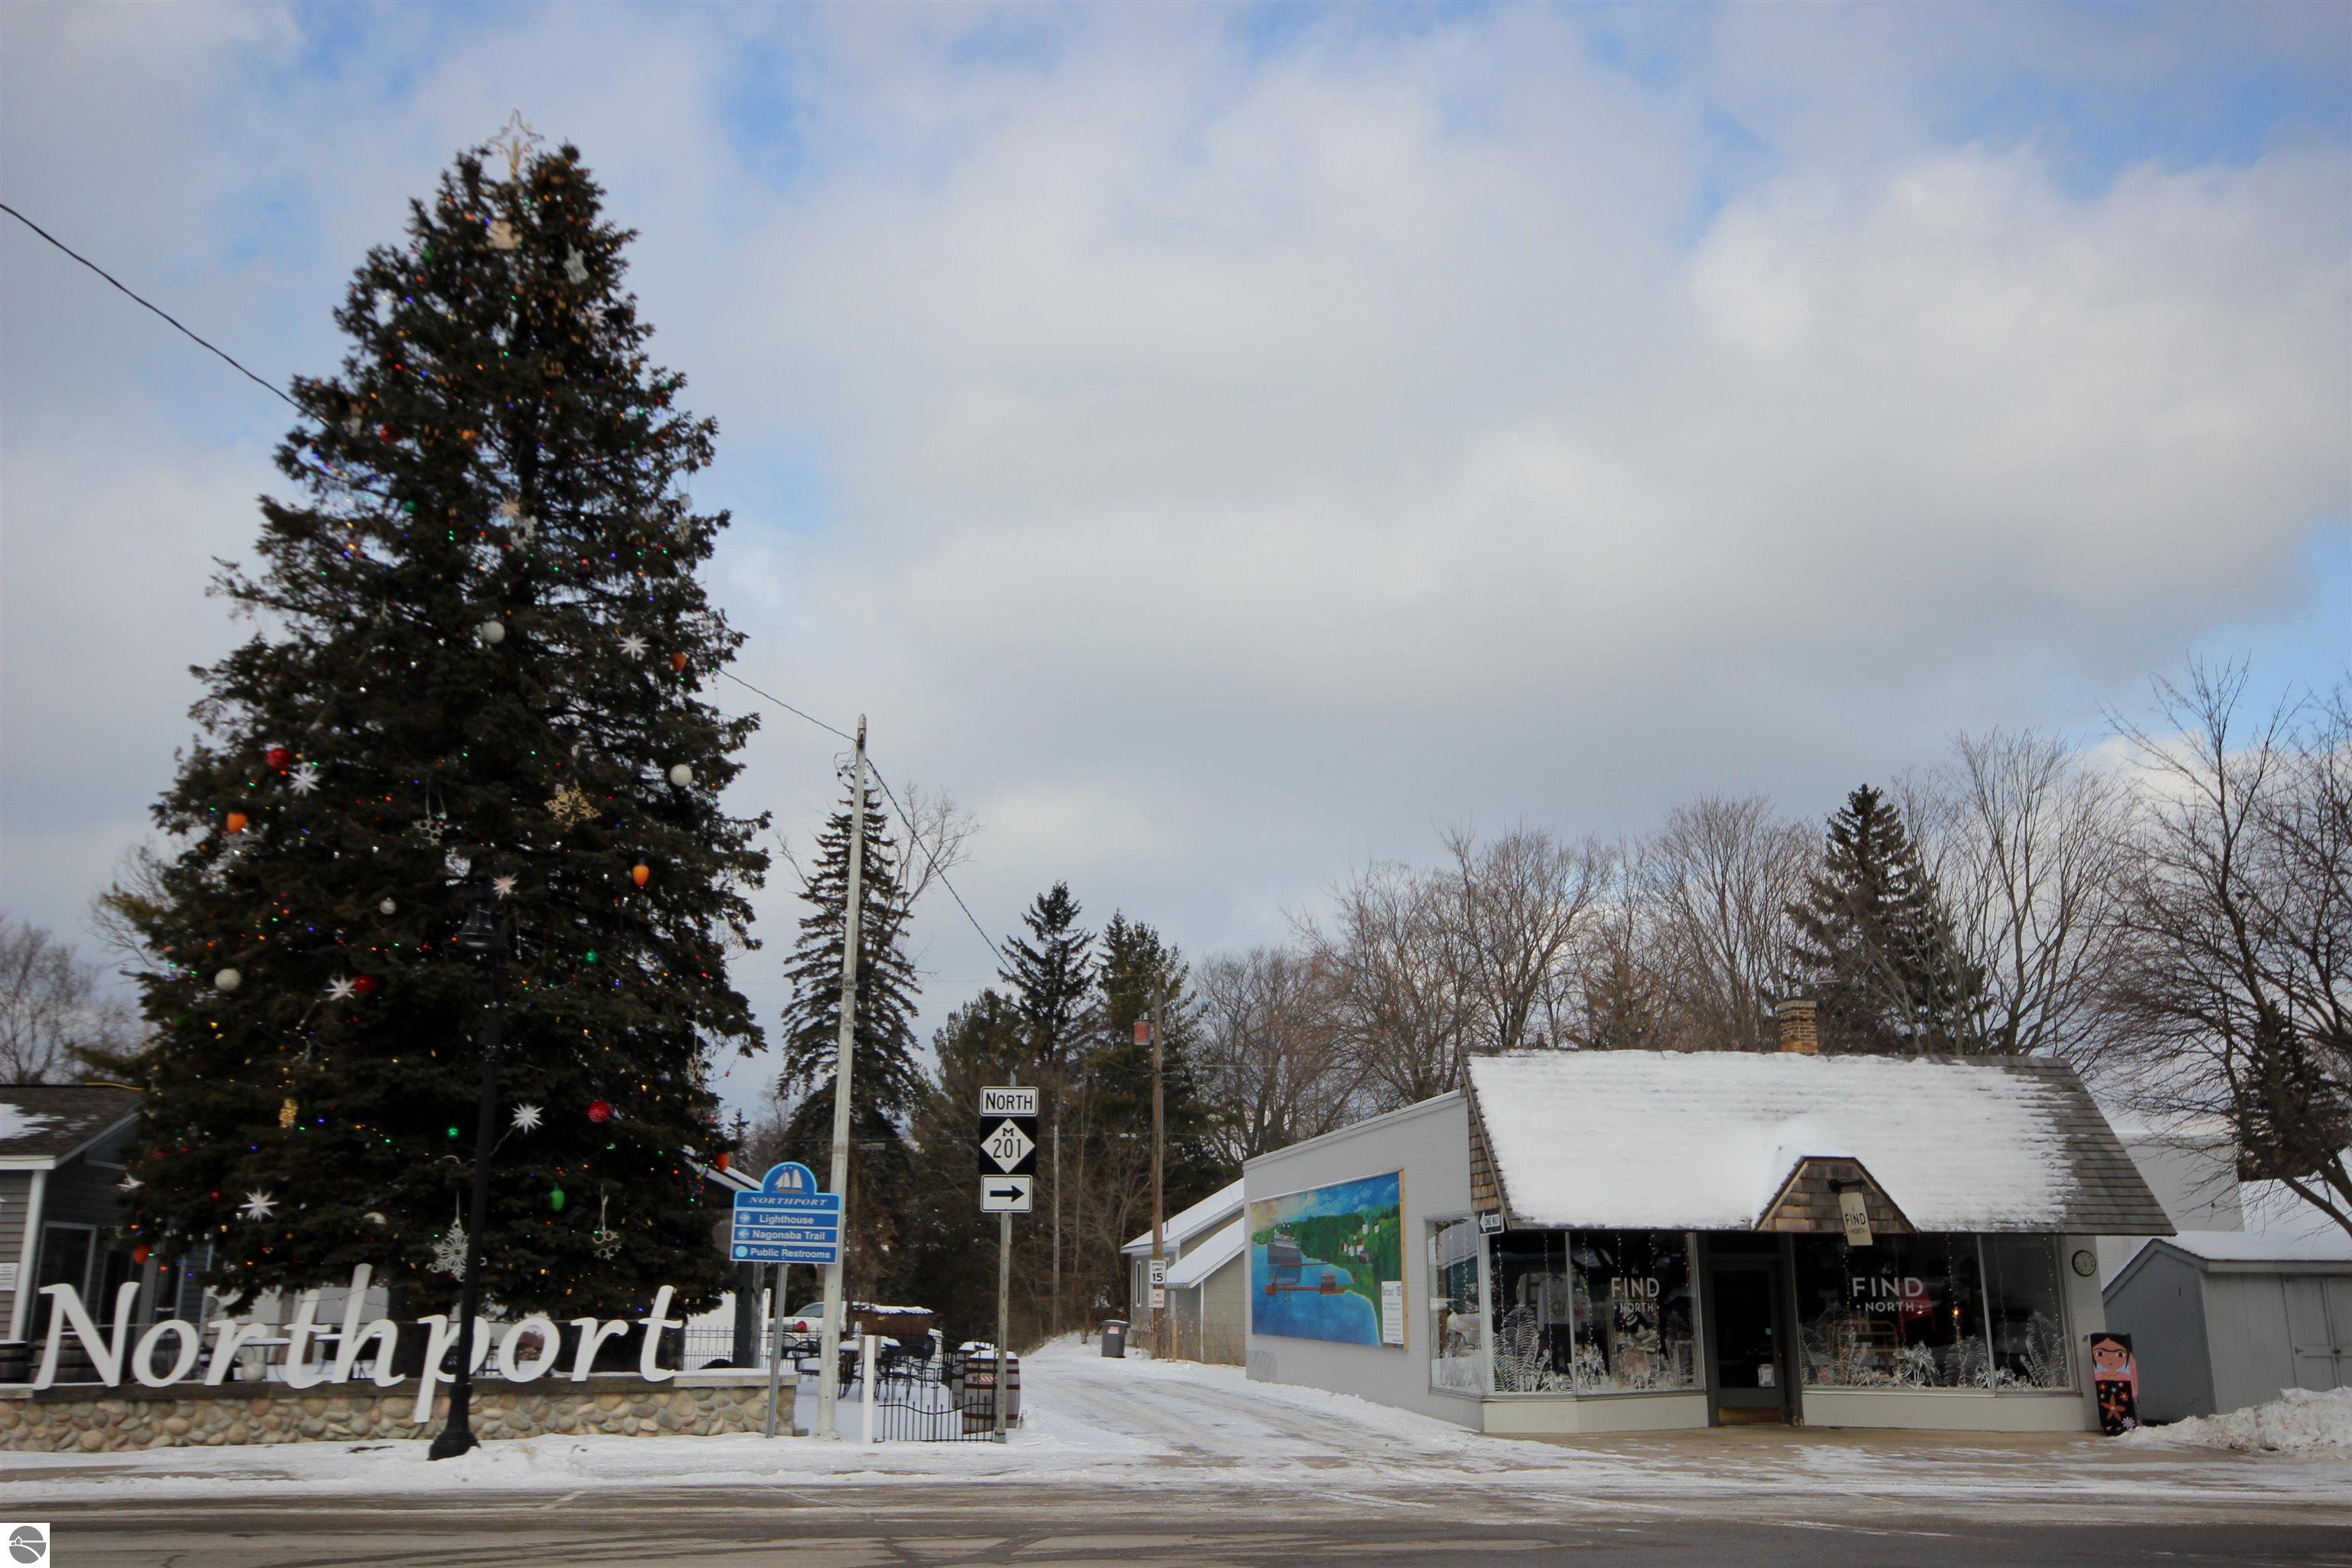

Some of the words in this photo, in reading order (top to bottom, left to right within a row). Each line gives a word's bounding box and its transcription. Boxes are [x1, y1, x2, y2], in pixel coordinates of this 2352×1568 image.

[985, 1093, 1033, 1110] NORTH
[1002, 1128, 1014, 1136] M
[993, 1138, 1021, 1158] 201
[750, 1197, 828, 1206] NORTHPORT
[760, 1214, 814, 1225] Lighthouse
[1844, 1213, 1866, 1225] FIND
[753, 1230, 802, 1240] Nagonaba
[805, 1231, 825, 1240] Trail
[750, 1248, 779, 1256] Public
[782, 1250, 831, 1259] Restrooms
[1152, 1272, 1164, 1282] 15
[1611, 1277, 1660, 1298] FIND
[1853, 1277, 1923, 1297] FIND
[1620, 1302, 1654, 1312] NORTH
[1865, 1302, 1914, 1312] NORTH
[34, 1264, 683, 1423] Northport
